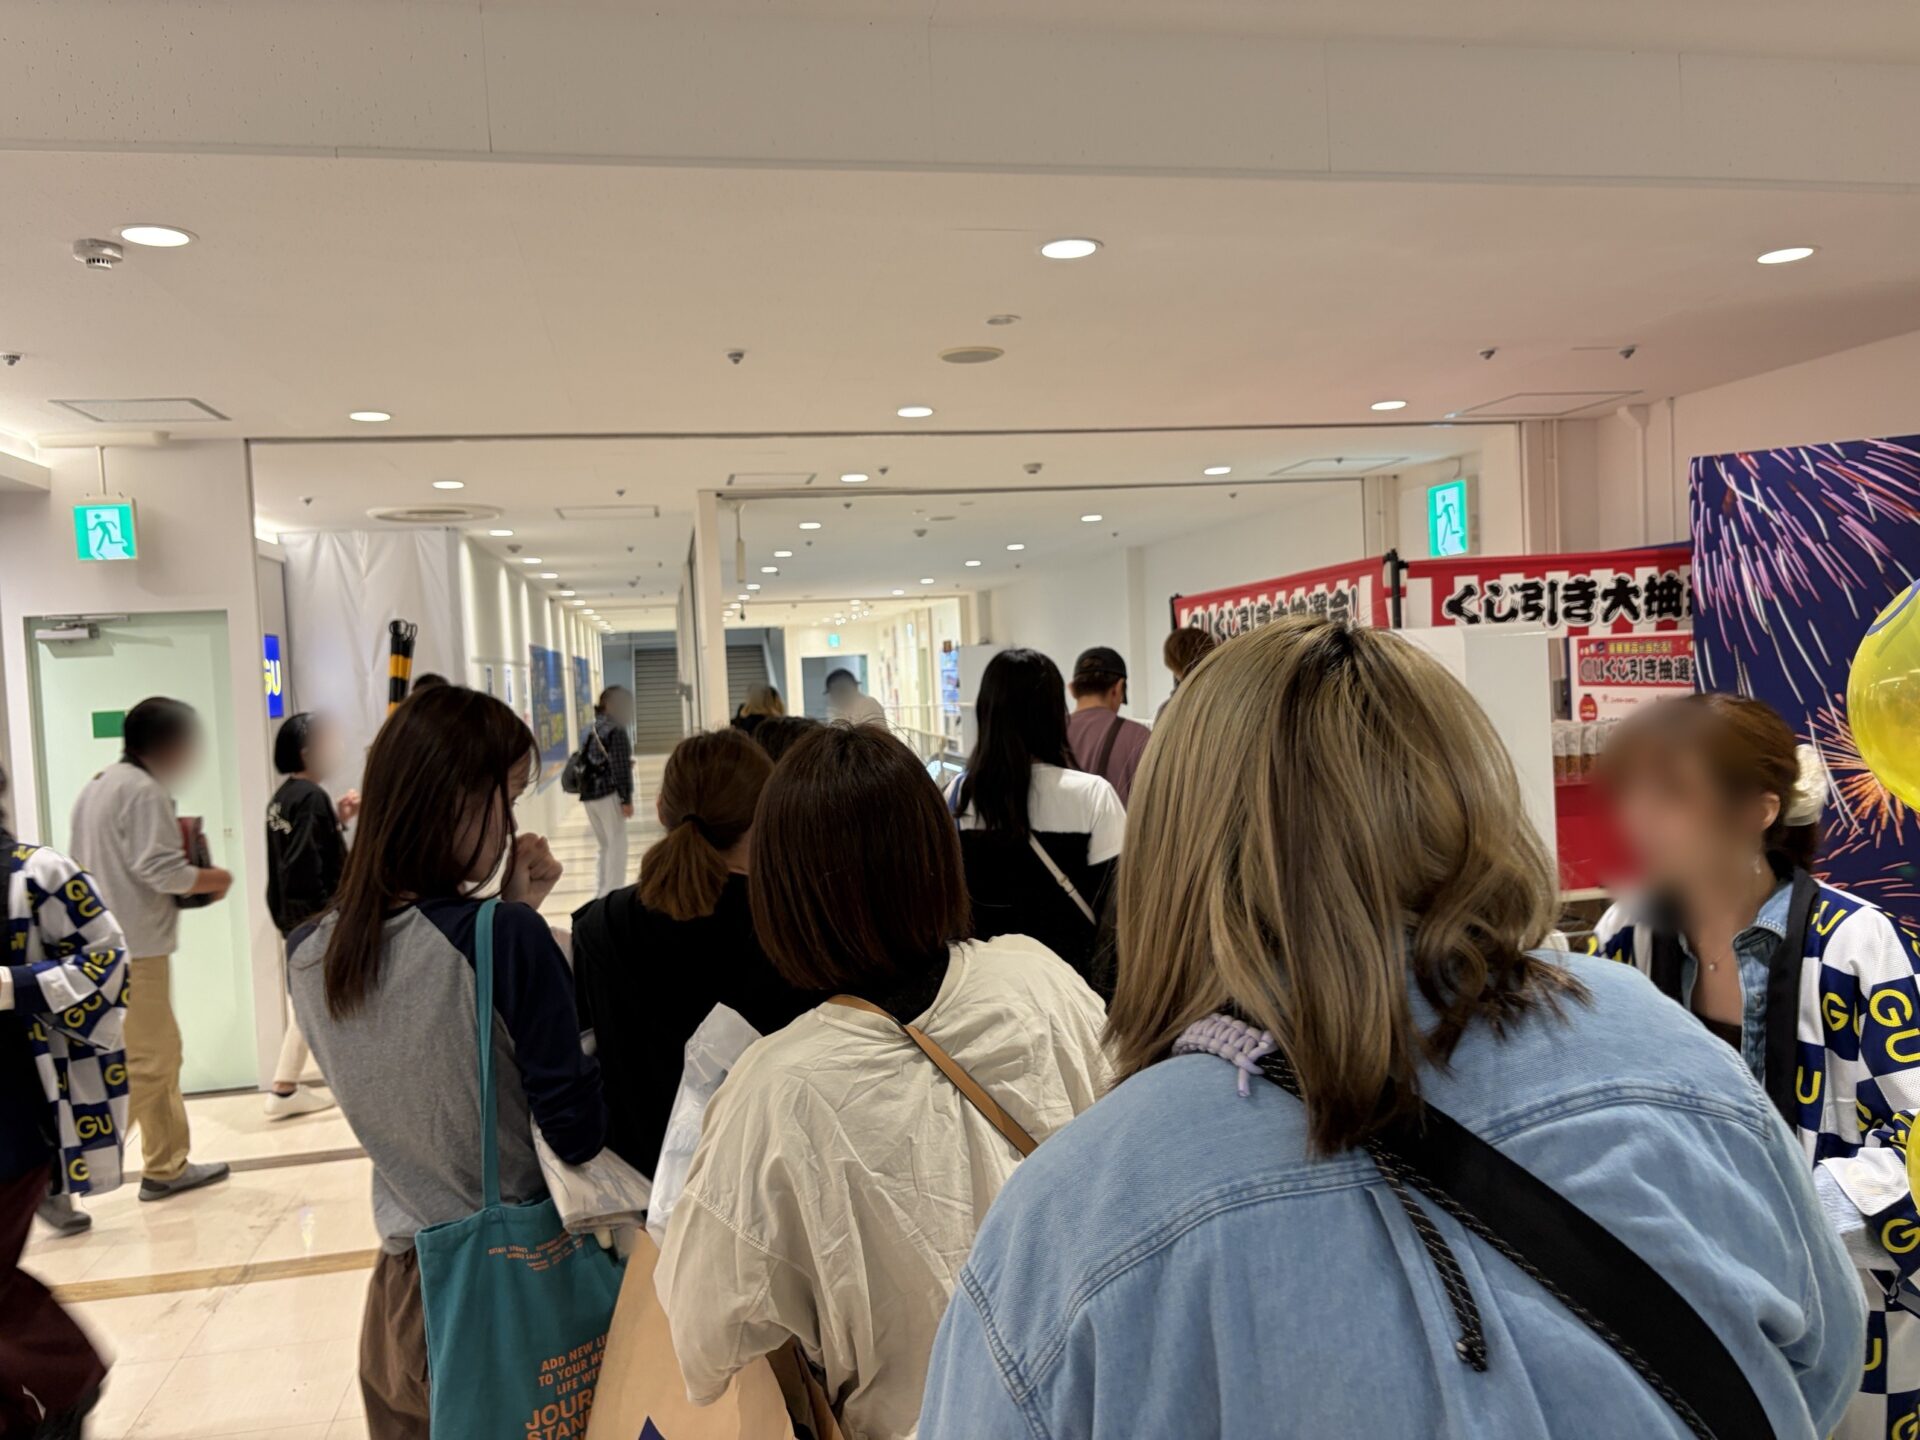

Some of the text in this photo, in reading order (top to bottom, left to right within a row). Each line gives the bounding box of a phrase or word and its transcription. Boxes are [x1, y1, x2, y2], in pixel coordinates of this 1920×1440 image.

[1445, 574, 1693, 626] くじ引き大抽
[65, 879, 104, 918] GU
[1811, 900, 1848, 936] U
[63, 994, 103, 1028] GU
[1869, 988, 1920, 1063] GU
[75, 1113, 113, 1139] GU
[538, 1373, 554, 1388] TO
[556, 1359, 588, 1381] YOUR
[541, 1355, 566, 1373] ADD
[568, 1340, 594, 1362] NEW
[556, 1377, 578, 1395] LIFE
[524, 1388, 593, 1430] JOUR
